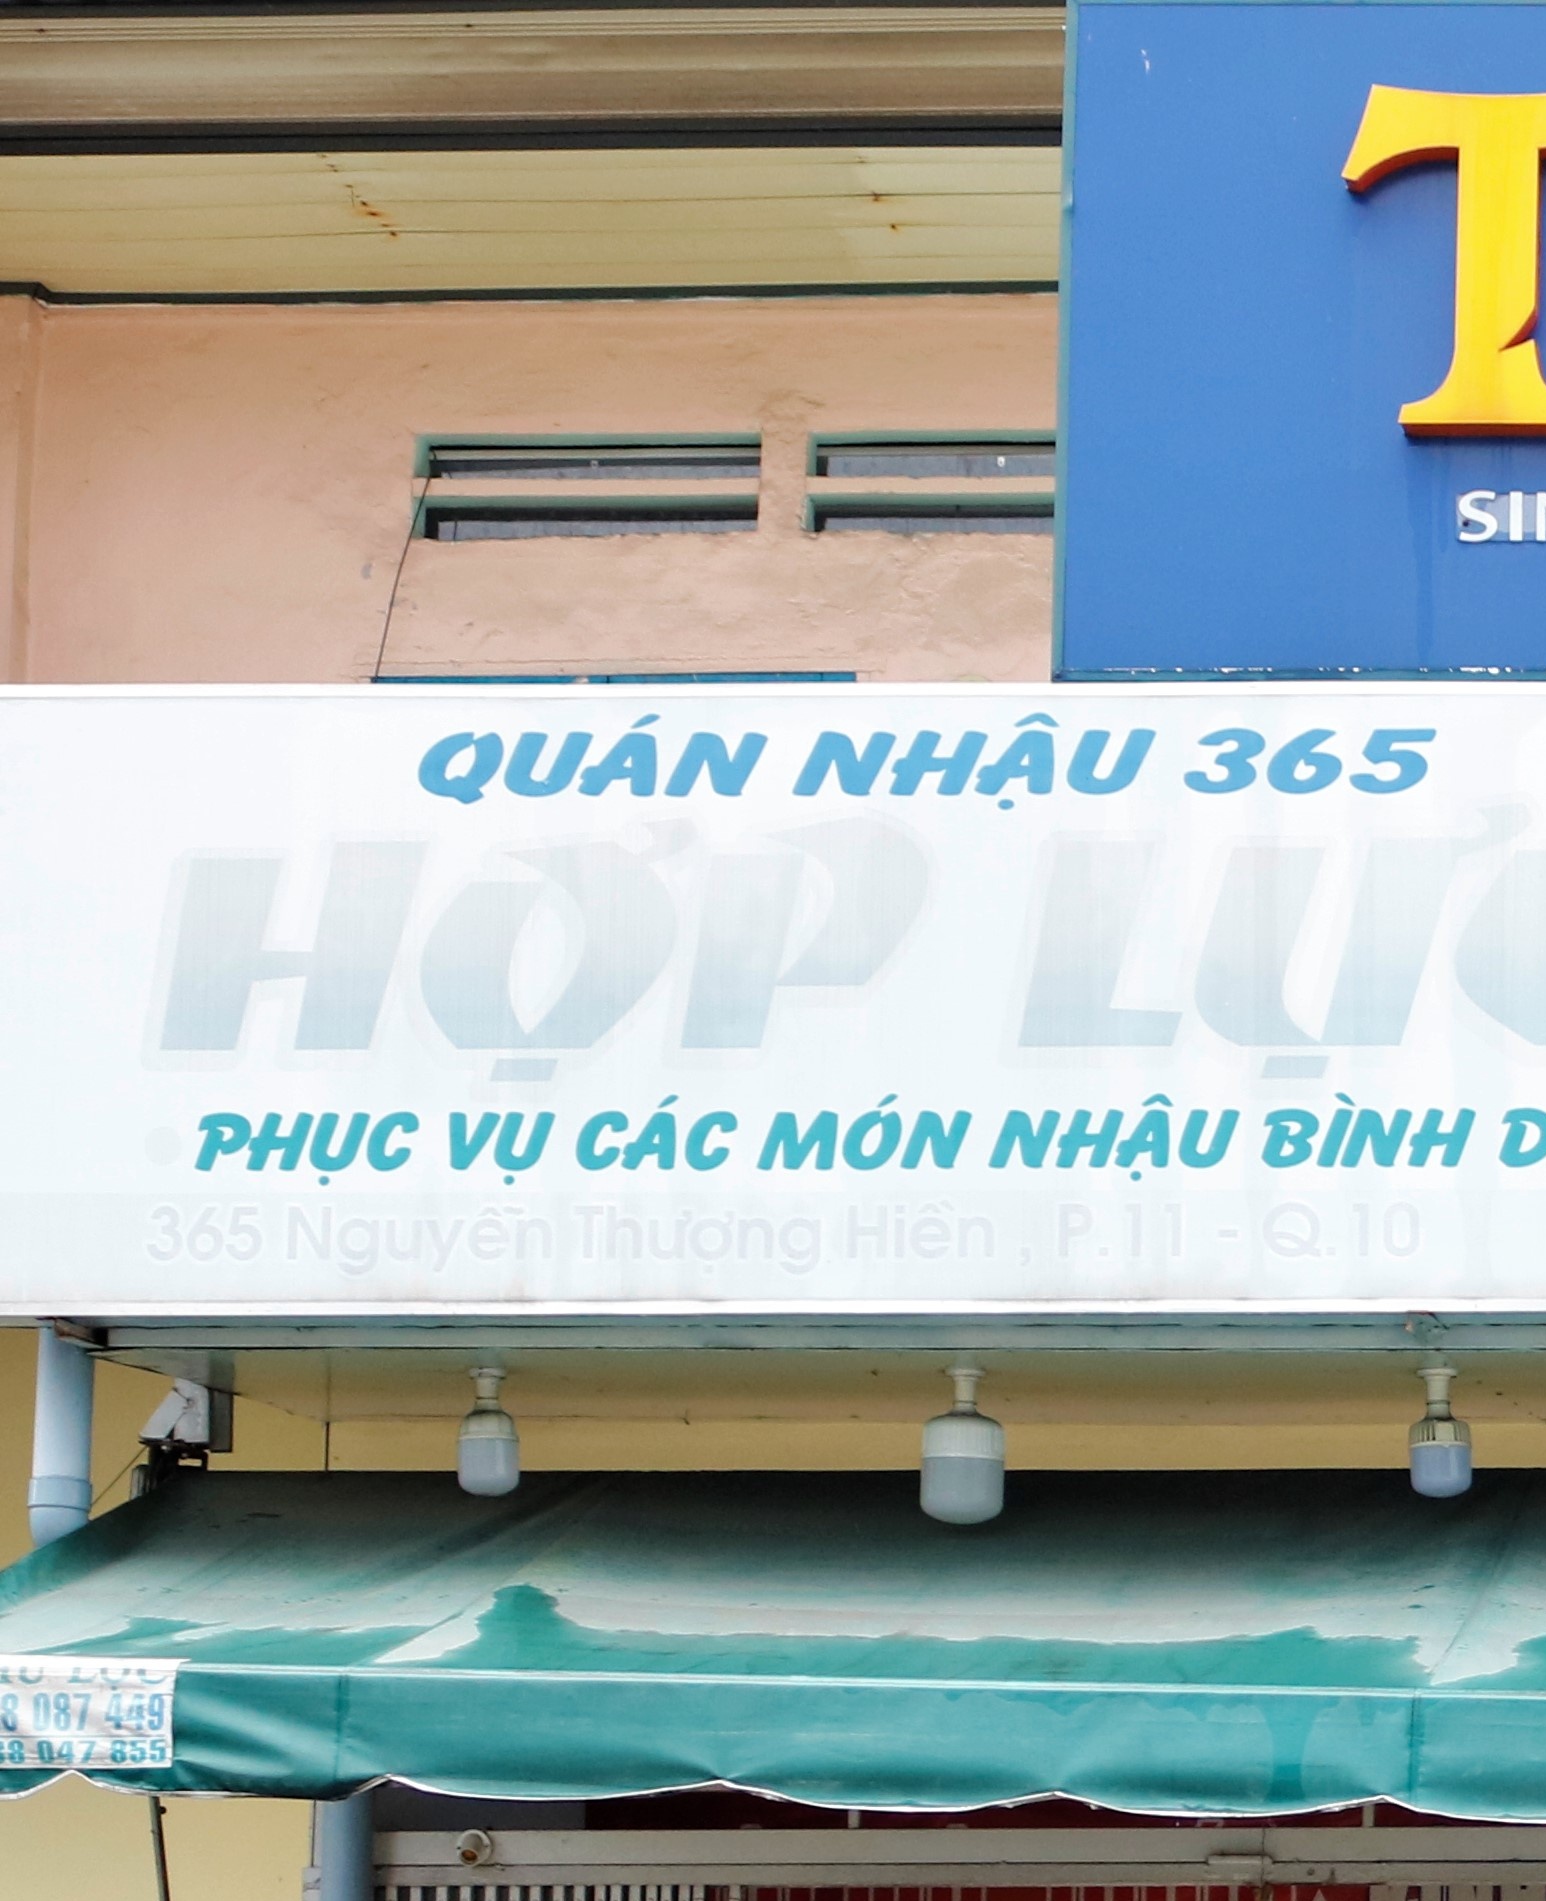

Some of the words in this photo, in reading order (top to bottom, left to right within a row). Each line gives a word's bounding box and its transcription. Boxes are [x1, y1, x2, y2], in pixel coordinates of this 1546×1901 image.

[417, 714, 768, 804] QUÁN
[791, 713, 1156, 810] NHẬU
[1184, 728, 1436, 794] 365
[159, 812, 933, 1082] HỢP
[195, 1109, 418, 1185] PHỤC
[448, 1111, 556, 1185] VỤ
[576, 1095, 737, 1171] CÁC
[758, 1093, 971, 1171] MÓN
[989, 1093, 1239, 1181] NHẬU
[1261, 1094, 1476, 1168] BÌNH
[147, 1206, 262, 1262] 365
[286, 1203, 553, 1276] Nguyễn
[575, 1206, 822, 1274] Thượng
[33, 1692, 92, 1731] 087
[105, 1692, 165, 1731] 449
[37, 1738, 96, 1764] 047
[110, 1738, 166, 1764] 855
